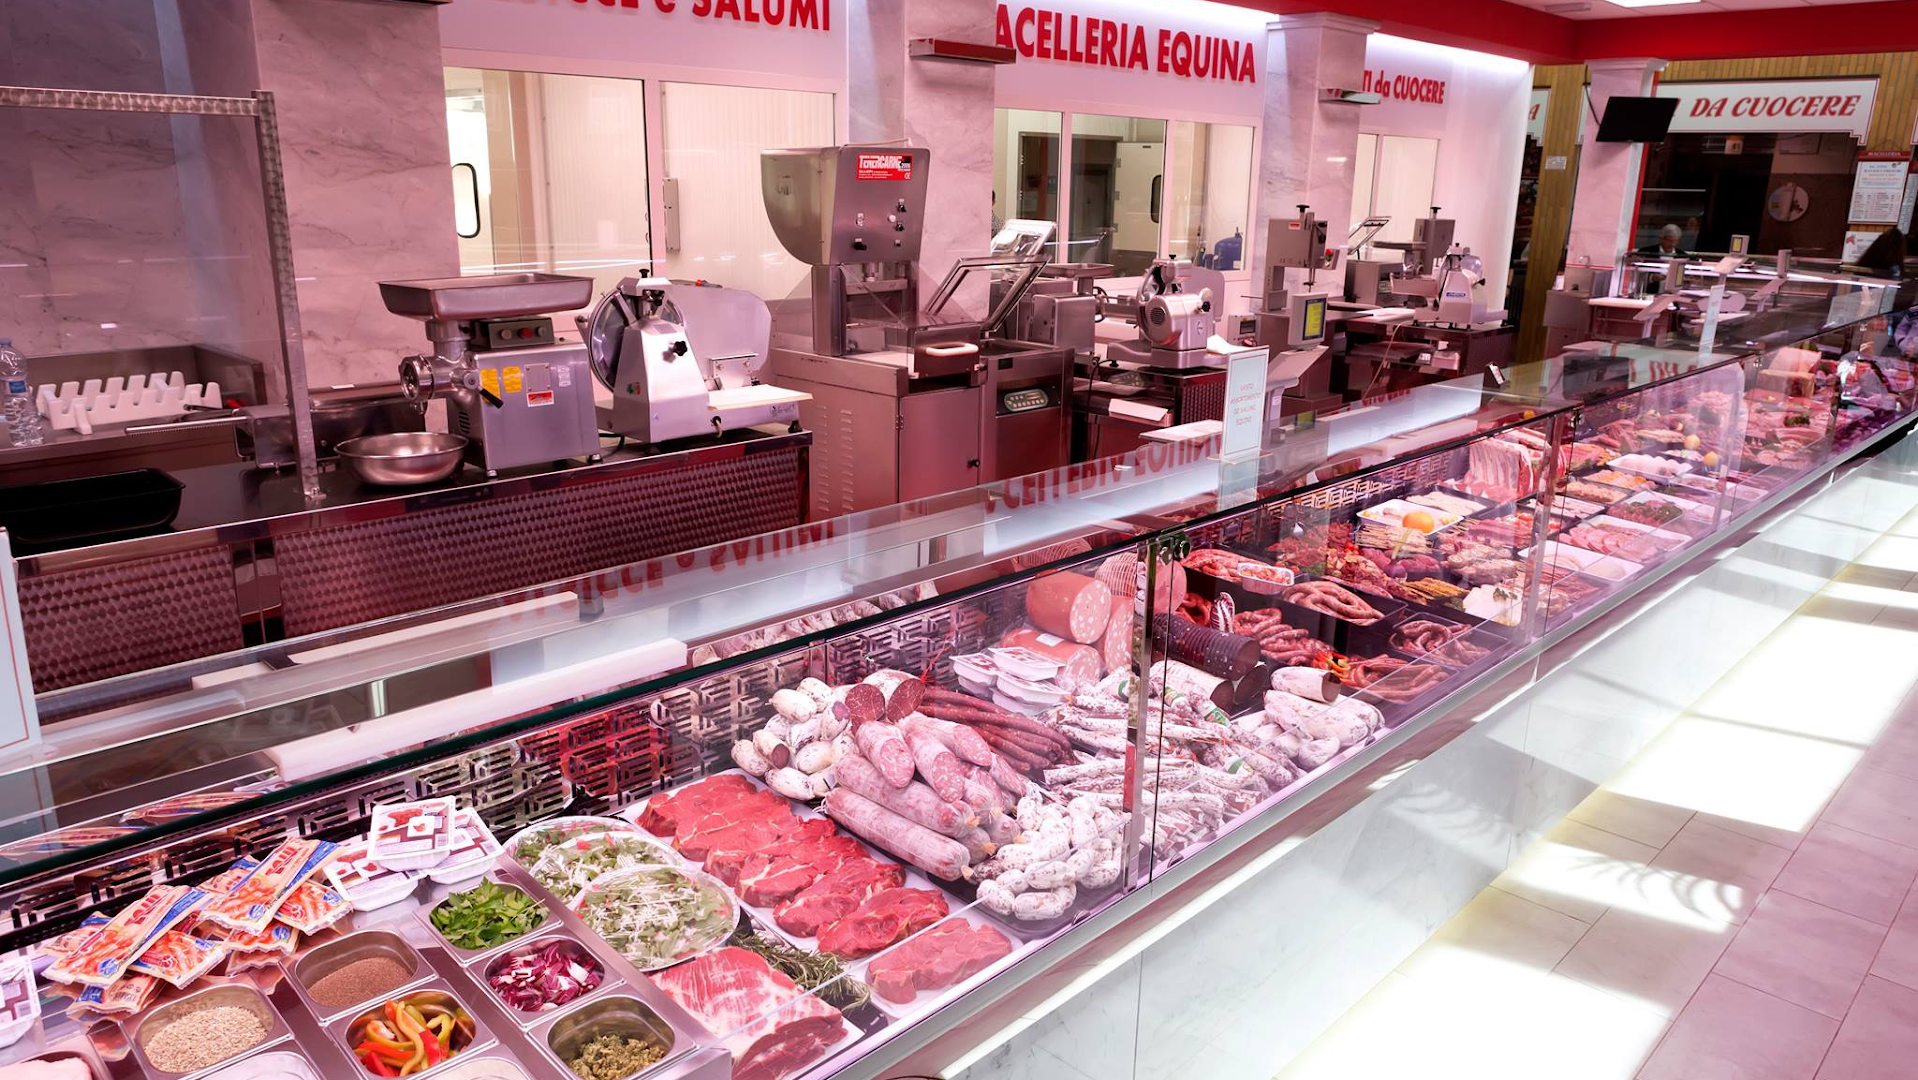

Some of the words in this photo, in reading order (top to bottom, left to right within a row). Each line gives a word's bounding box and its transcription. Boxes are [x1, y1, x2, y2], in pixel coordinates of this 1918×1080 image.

[692, 0, 830, 31] LUMI
[996, 4, 1149, 70] ACELLERIA
[1157, 29, 1256, 83] EQUINA
[1374, 70, 1391, 98] da
[1393, 74, 1445, 104] CUOCERE
[1529, 103, 1540, 121] A
[1690, 97, 1729, 117] DA
[1731, 95, 1861, 117] CUOCERE
